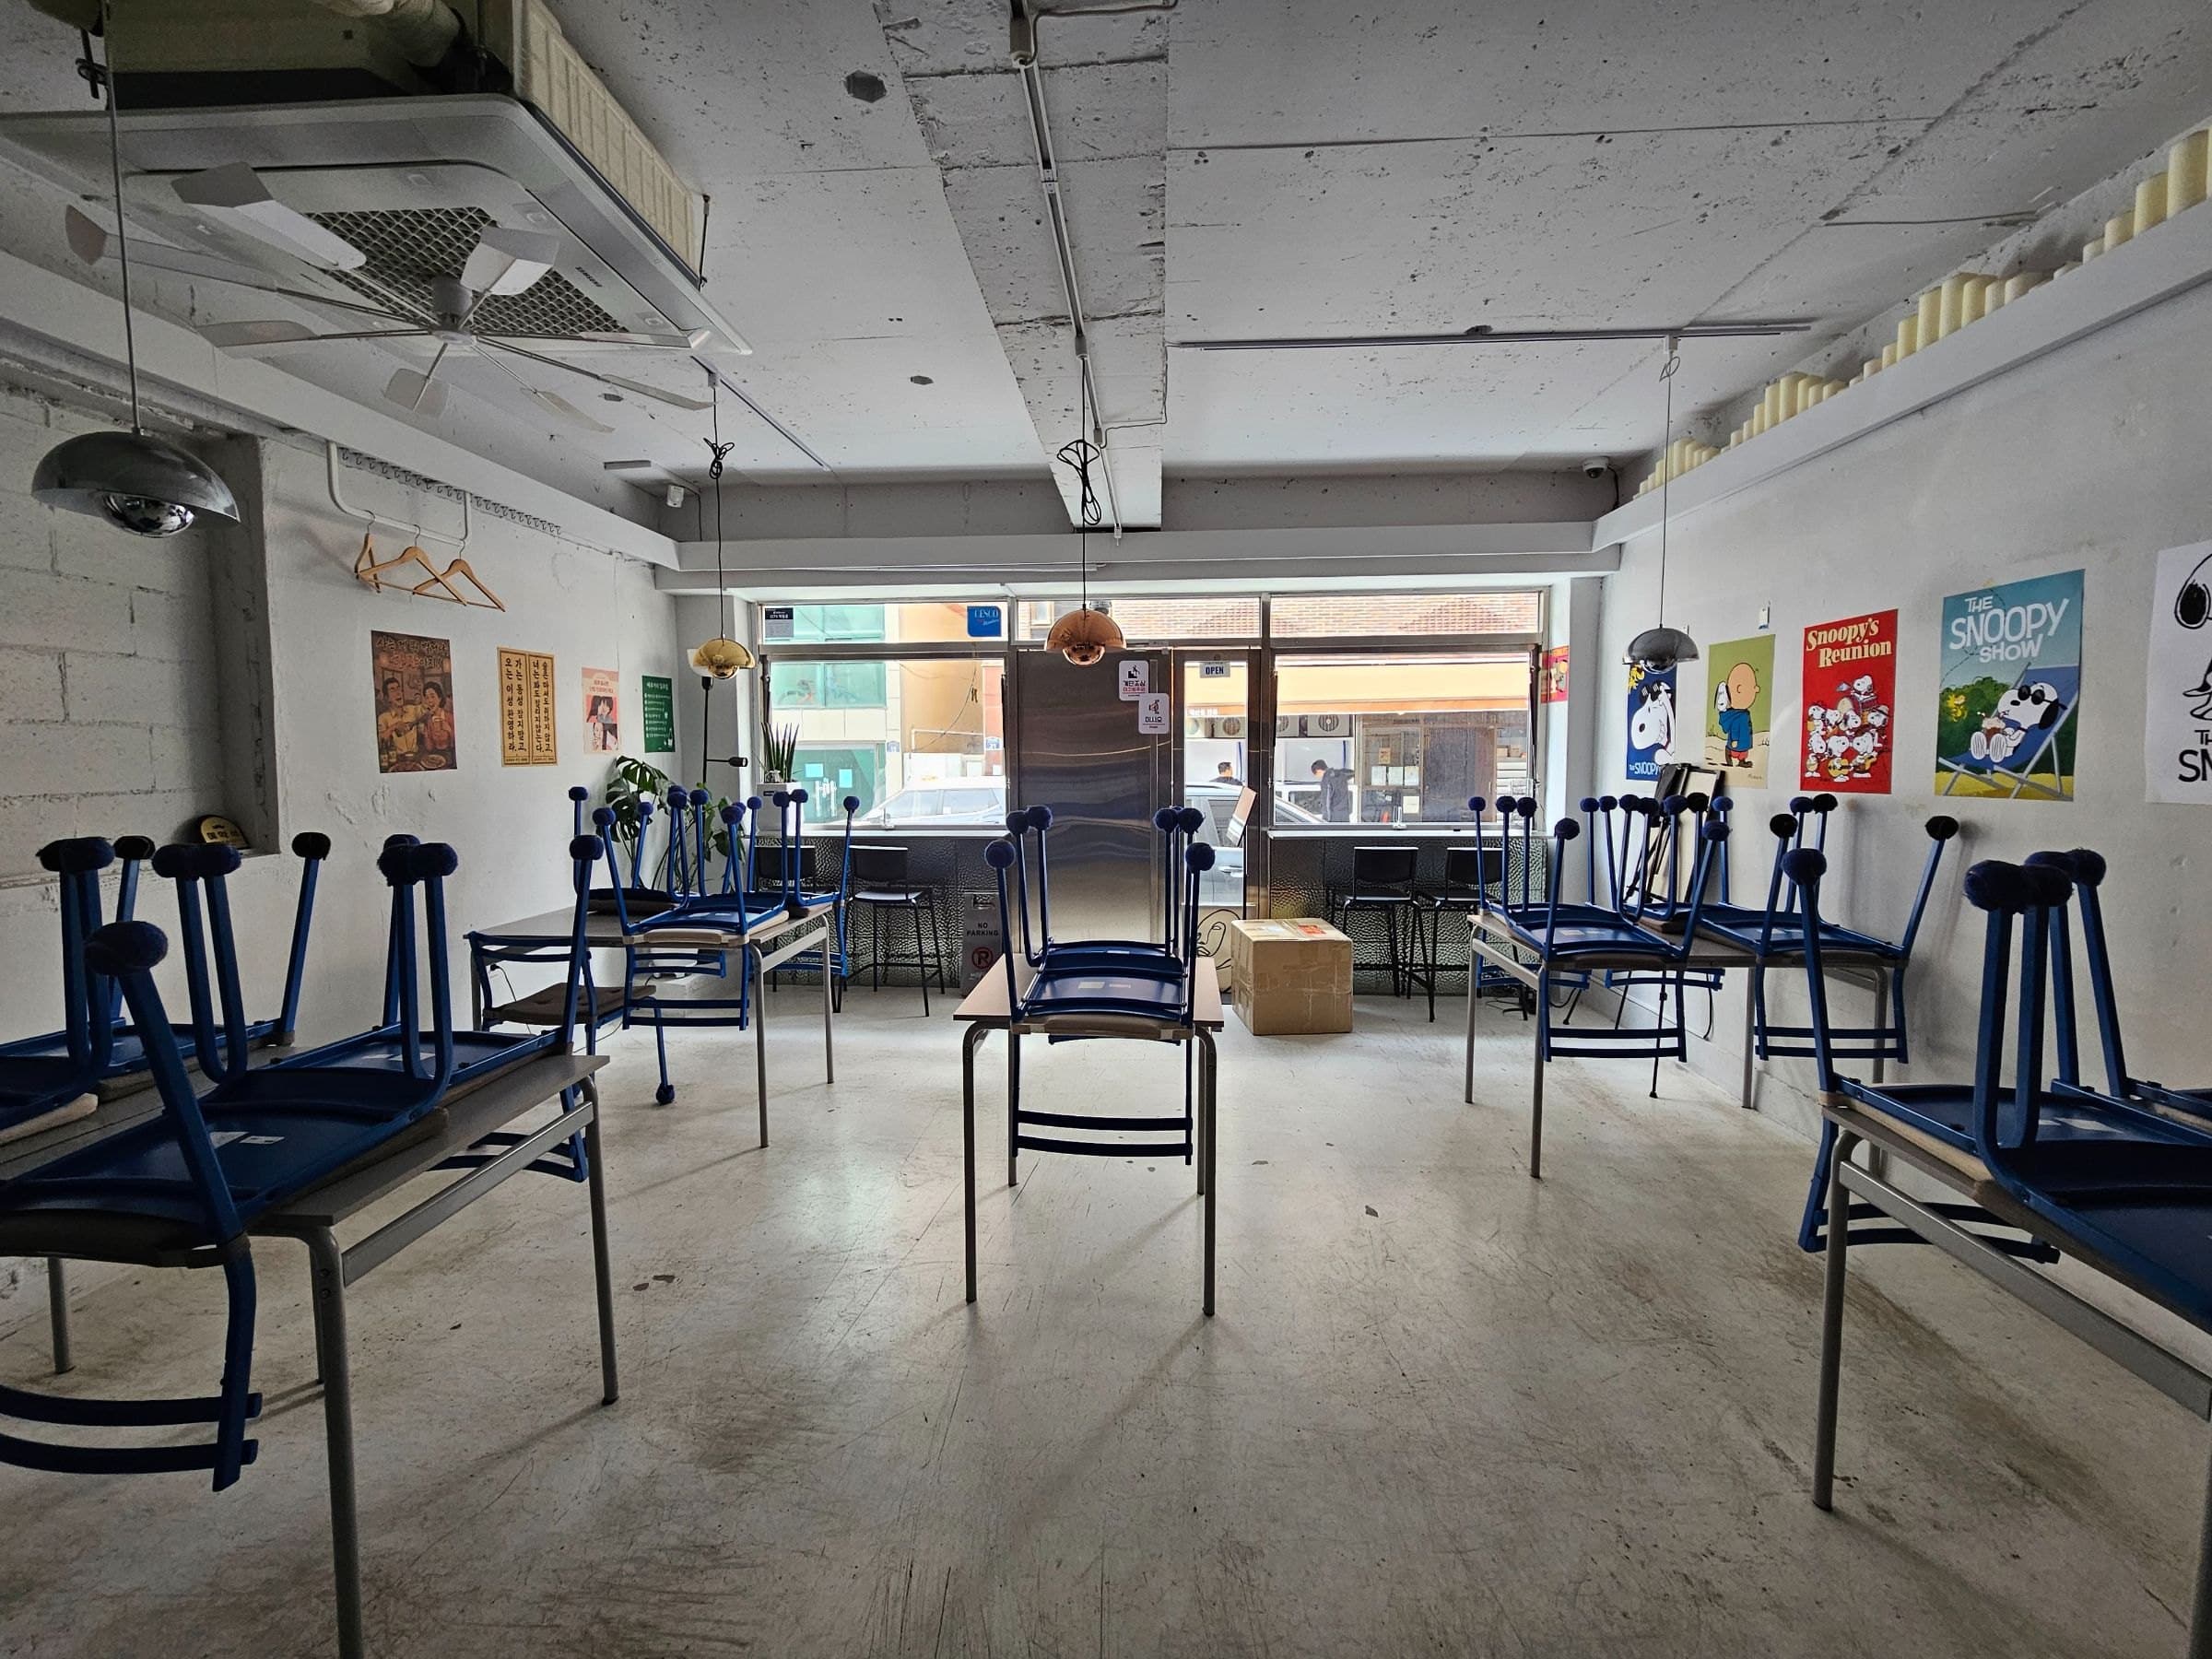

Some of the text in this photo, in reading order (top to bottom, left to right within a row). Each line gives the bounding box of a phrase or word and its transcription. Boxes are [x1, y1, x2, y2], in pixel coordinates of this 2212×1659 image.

[1964, 595, 1994, 613] THE
[1806, 618, 1879, 652] Snoopy's
[1949, 598, 2070, 650] SNOOPY
[1818, 639, 1892, 668] Reunion
[1979, 633, 2044, 664] SHOW
[505, 657, 512, 680] 오는
[515, 658, 523, 680] 가는
[1205, 665, 1224, 675] OPEN
[506, 683, 513, 706] 이성
[516, 684, 524, 706] 동성
